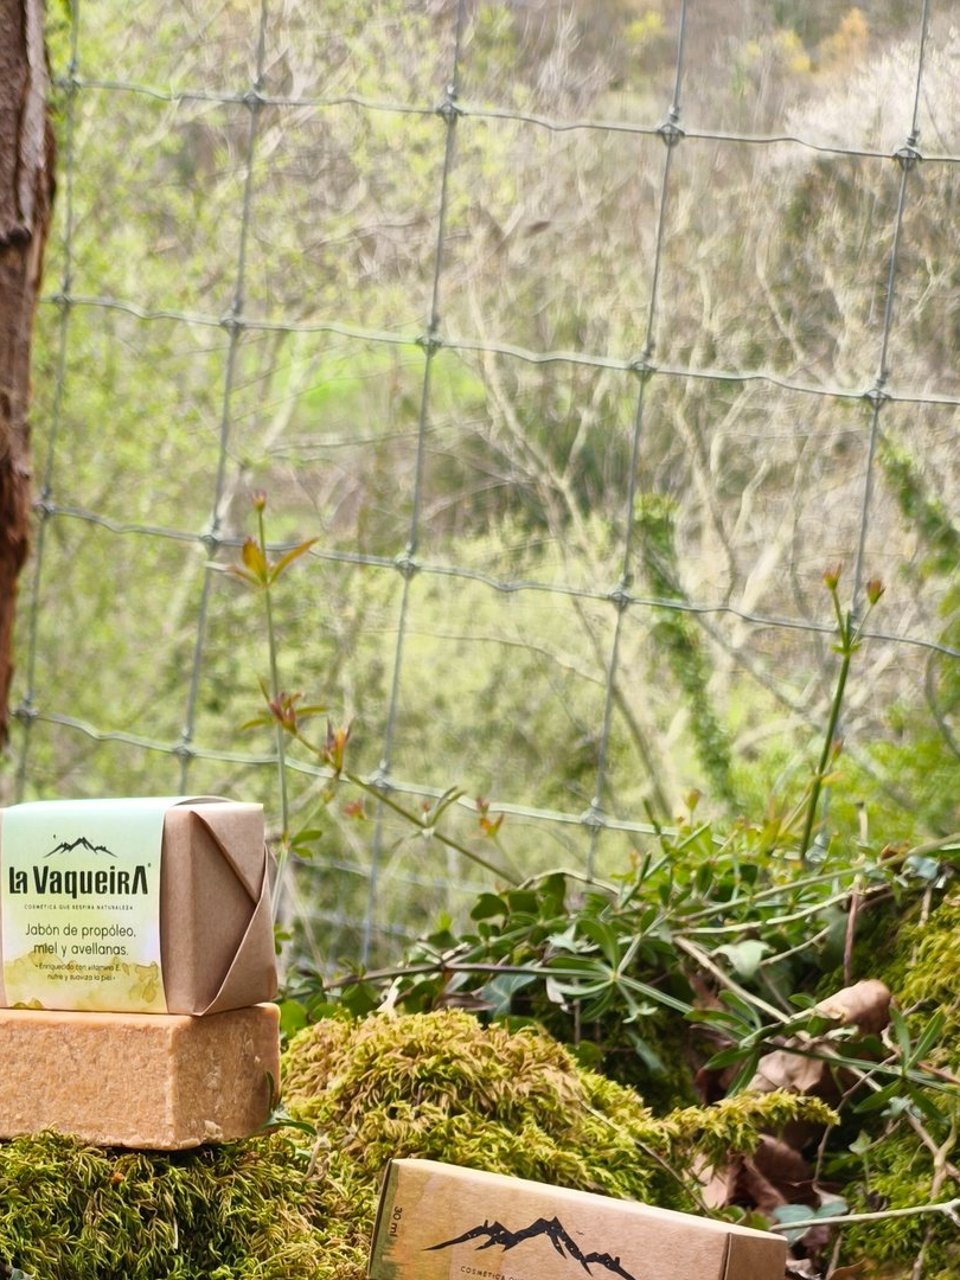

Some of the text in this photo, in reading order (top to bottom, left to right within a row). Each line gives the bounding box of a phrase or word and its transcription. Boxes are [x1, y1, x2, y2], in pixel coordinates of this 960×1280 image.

[8, 866, 28, 895] La
[25, 923, 136, 939] Jabón de propóleo,
[33, 941, 57, 954] miel
[61, 945, 67, 957] y
[389, 1206, 403, 1237] 30 ml
